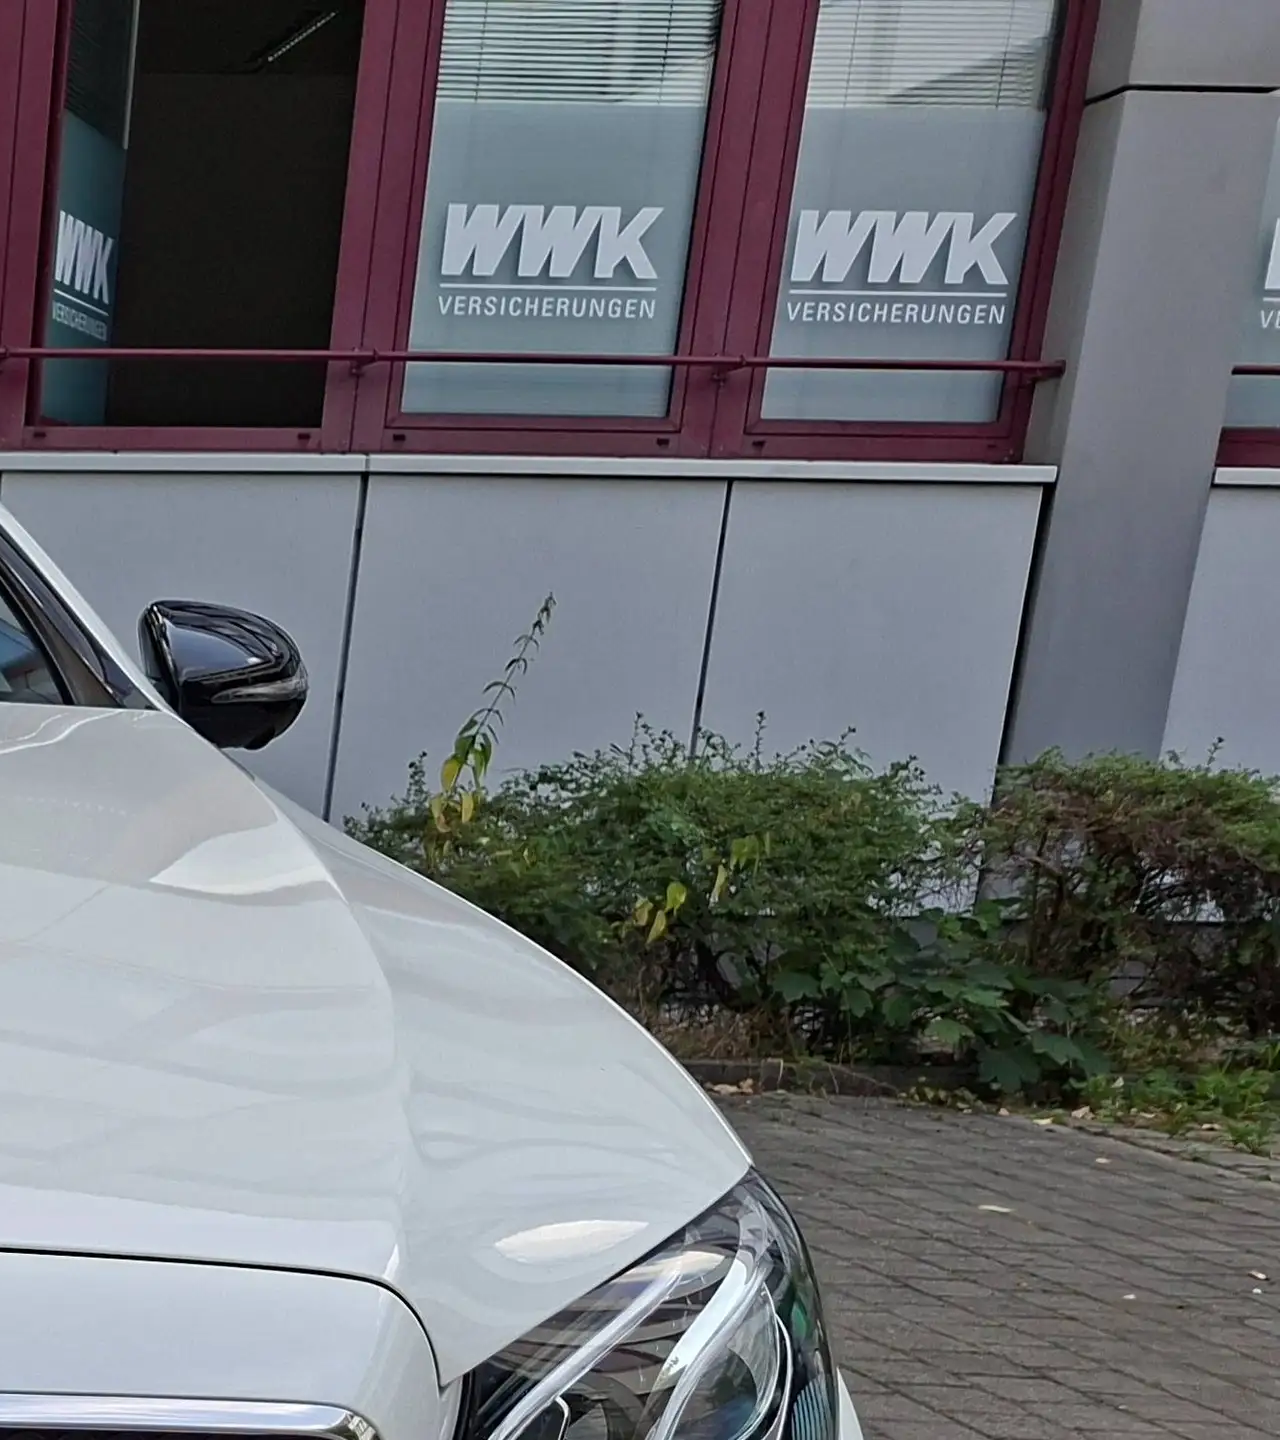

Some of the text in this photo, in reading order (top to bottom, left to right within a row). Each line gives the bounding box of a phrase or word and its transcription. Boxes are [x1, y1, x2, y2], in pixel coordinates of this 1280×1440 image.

[54, 210, 115, 305] WWK
[441, 202, 665, 279] WWK
[790, 209, 1018, 285] WWK
[438, 296, 657, 319] VERSICHERUNGEN
[787, 302, 1006, 325] VERSICHERUNGEN
